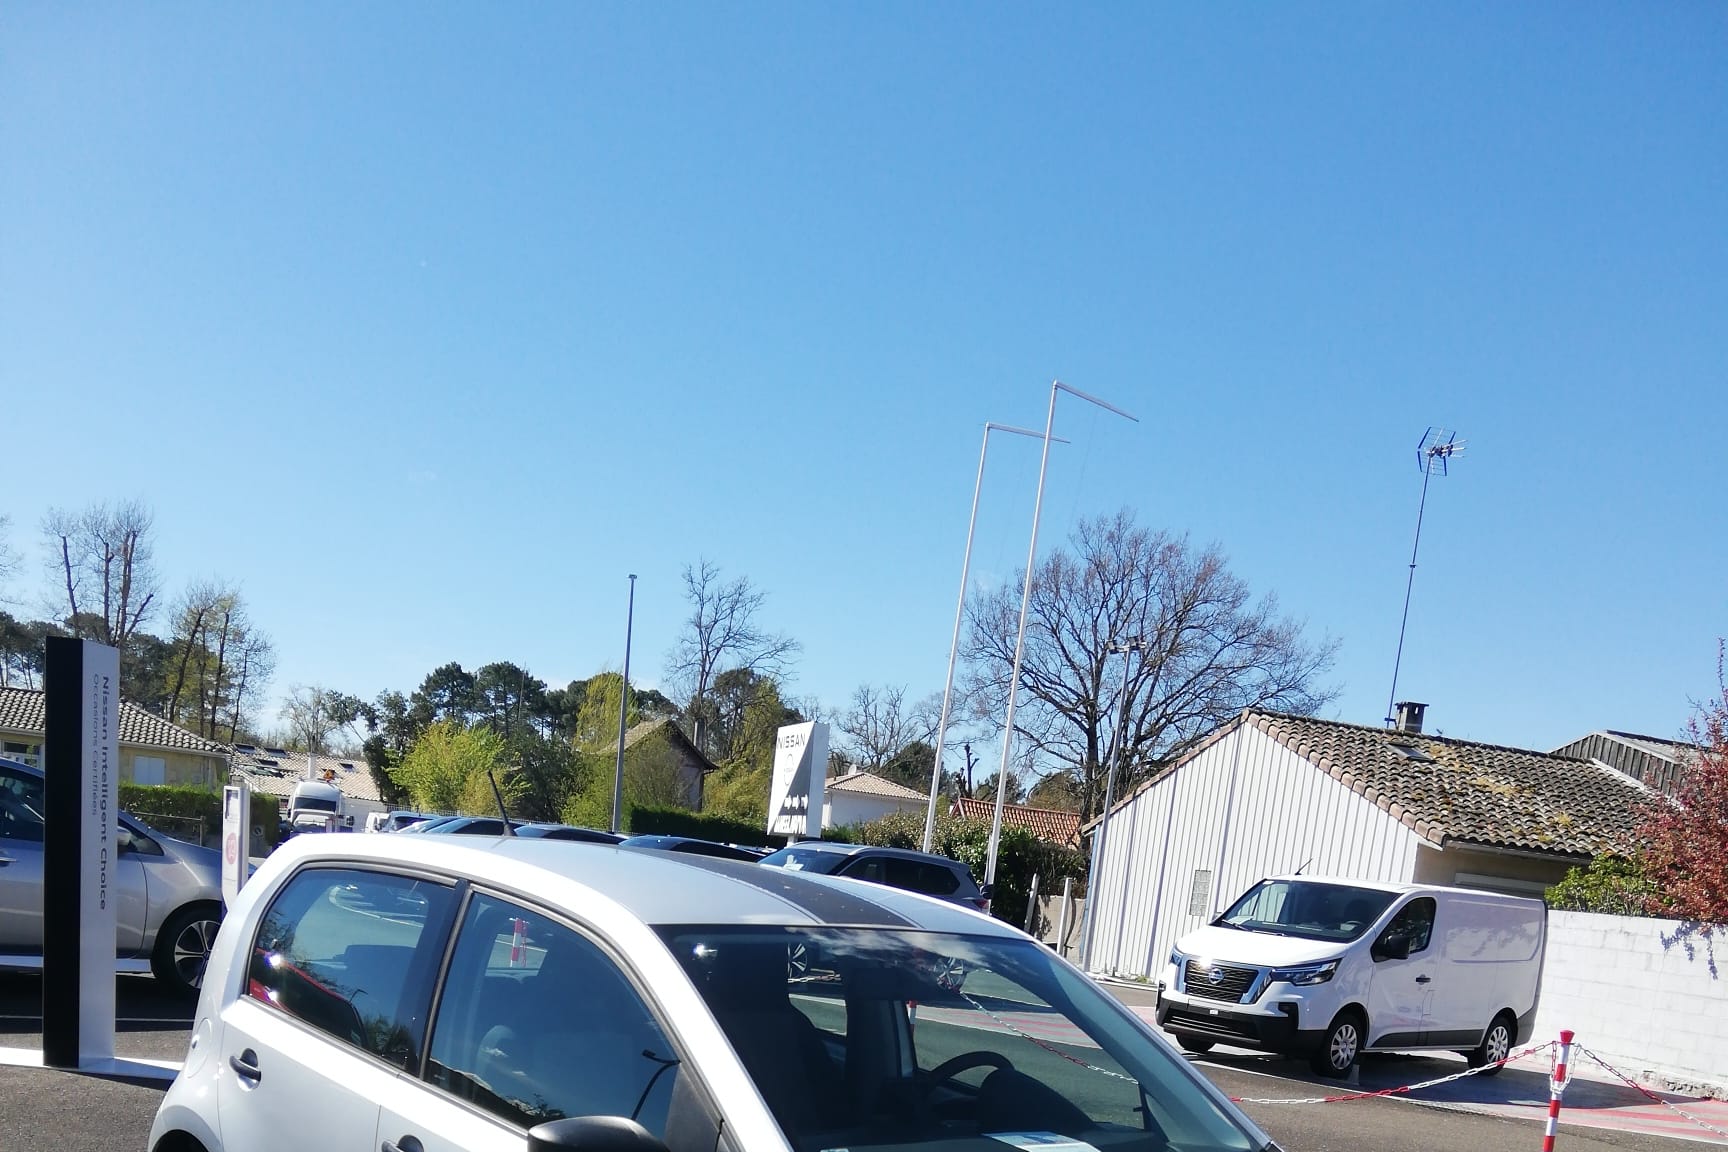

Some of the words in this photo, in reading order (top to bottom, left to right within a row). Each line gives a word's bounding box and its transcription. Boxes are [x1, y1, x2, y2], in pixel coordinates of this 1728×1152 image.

[92, 673, 100, 746] Occasions
[102, 676, 110, 740] Nissan
[777, 733, 806, 750] NISSAN
[99, 746, 109, 843] Intelligent
[99, 848, 108, 910] Choice
